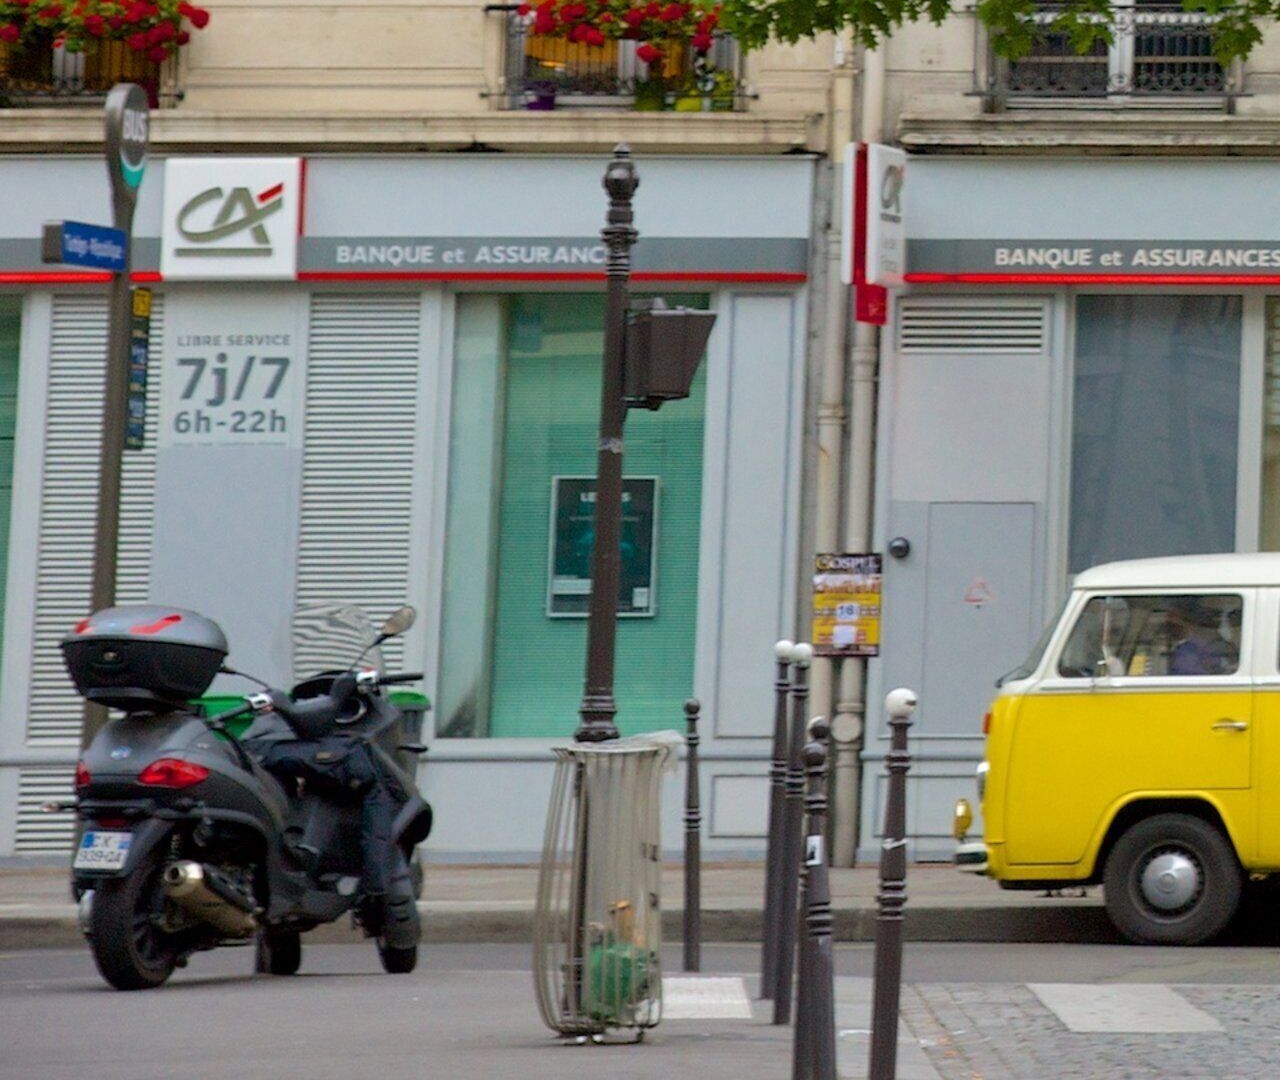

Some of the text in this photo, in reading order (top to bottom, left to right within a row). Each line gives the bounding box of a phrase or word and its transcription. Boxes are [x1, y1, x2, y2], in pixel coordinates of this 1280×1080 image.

[123, 109, 147, 141] BUS
[336, 245, 606, 265] BANQUE et ASSURANC
[995, 248, 1092, 268] BANQUE
[1100, 250, 1124, 266] et
[177, 335, 291, 346] LIBRE SERVICE
[176, 352, 290, 407] 7j/7
[174, 409, 287, 434] 6h-22h
